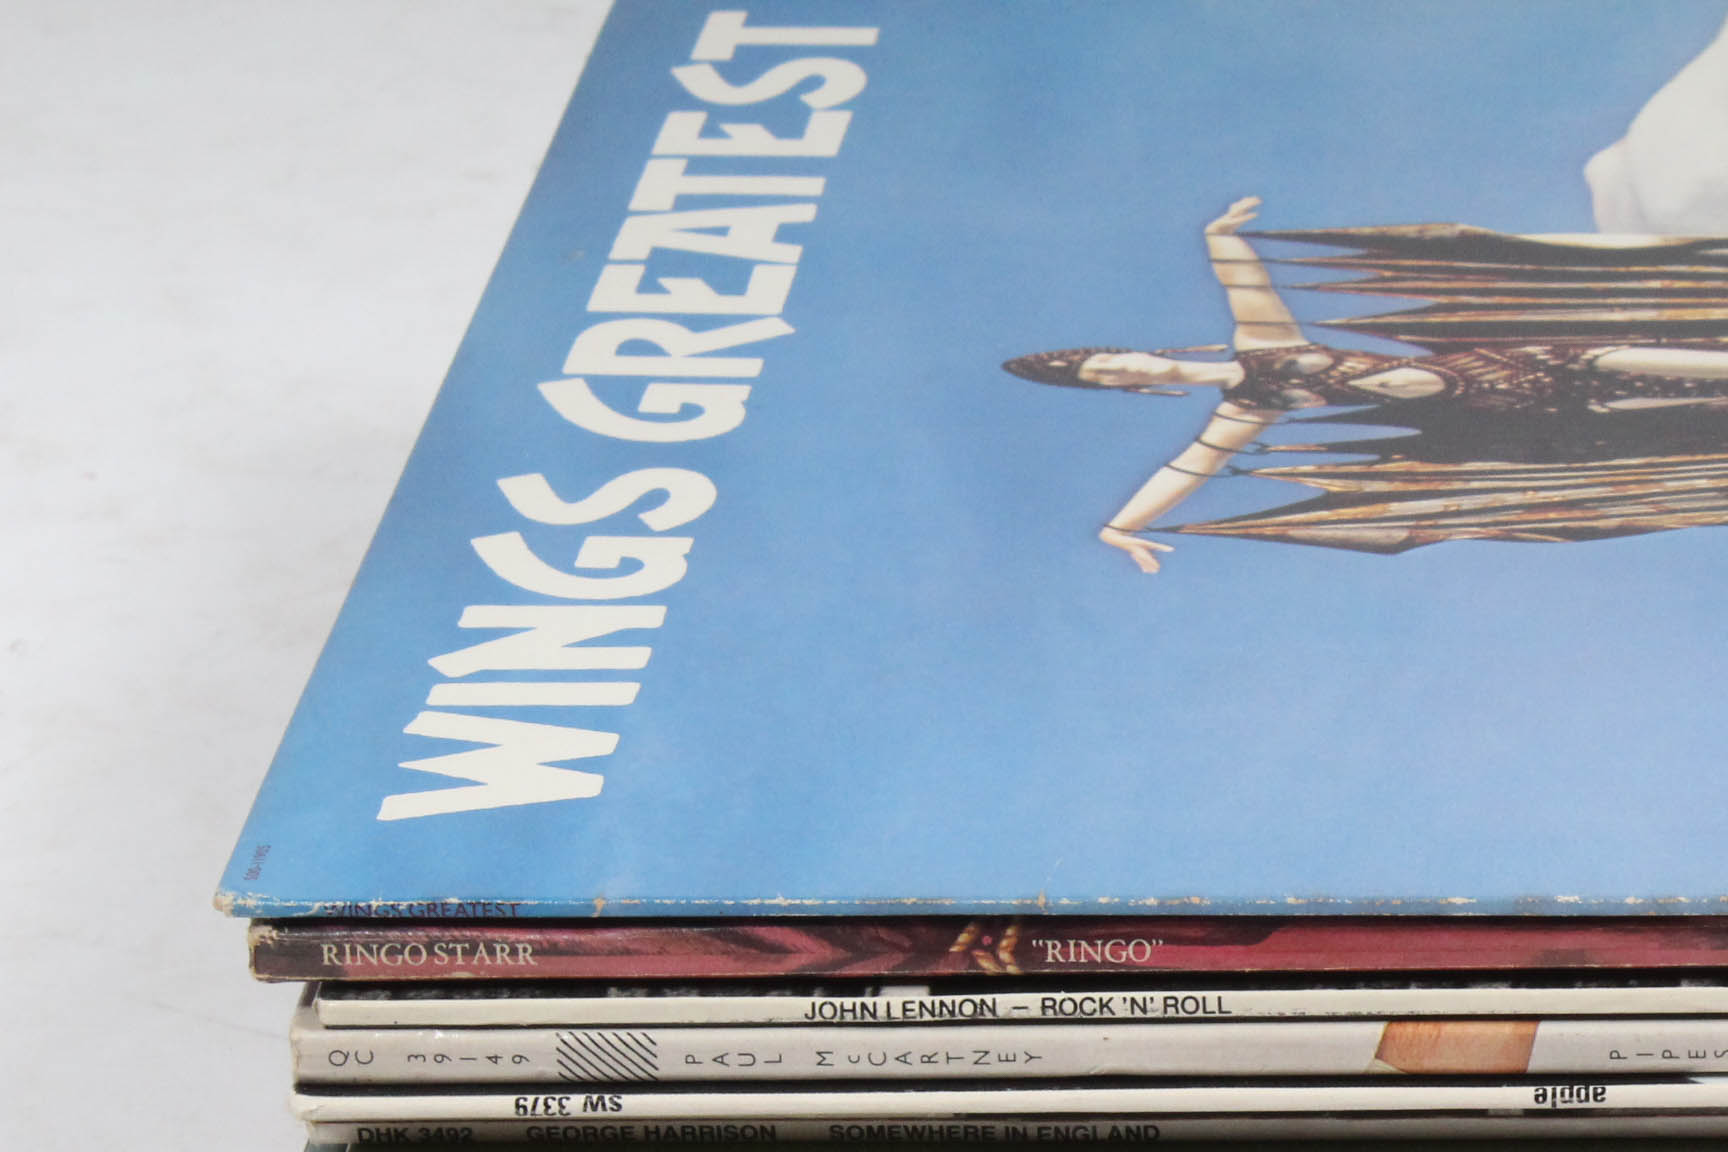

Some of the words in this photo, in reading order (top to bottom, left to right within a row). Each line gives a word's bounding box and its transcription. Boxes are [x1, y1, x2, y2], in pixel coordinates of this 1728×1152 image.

[537, 10, 880, 443] GREATEST
[377, 467, 718, 820] WINGS
[320, 943, 427, 966] RINGO
[434, 943, 537, 966] STARR
[1030, 938, 1165, 964] "RINGO"
[804, 1000, 878, 1022] JOHN
[886, 998, 998, 1019] LENNON
[1041, 997, 1117, 1018] ROCK
[1122, 996, 1155, 1016] 'N'
[1163, 995, 1232, 1015] ROLL
[686, 1051, 782, 1068] PAUL
[815, 1048, 1043, 1067] McCARTNEY
[584, 1095, 624, 1111] SW
[1534, 1085, 1606, 1103] apple
[514, 1095, 572, 1115] 3379
[357, 1128, 410, 1143] DHK
[418, 1128, 474, 1143] 3492
[526, 1126, 637, 1143] GEORGE
[644, 1125, 777, 1142] HARRISON
[829, 1124, 997, 1143] SOMEWHERE
[1004, 1126, 1030, 1142] IN
[1036, 1125, 1161, 1143] ENGLAND
